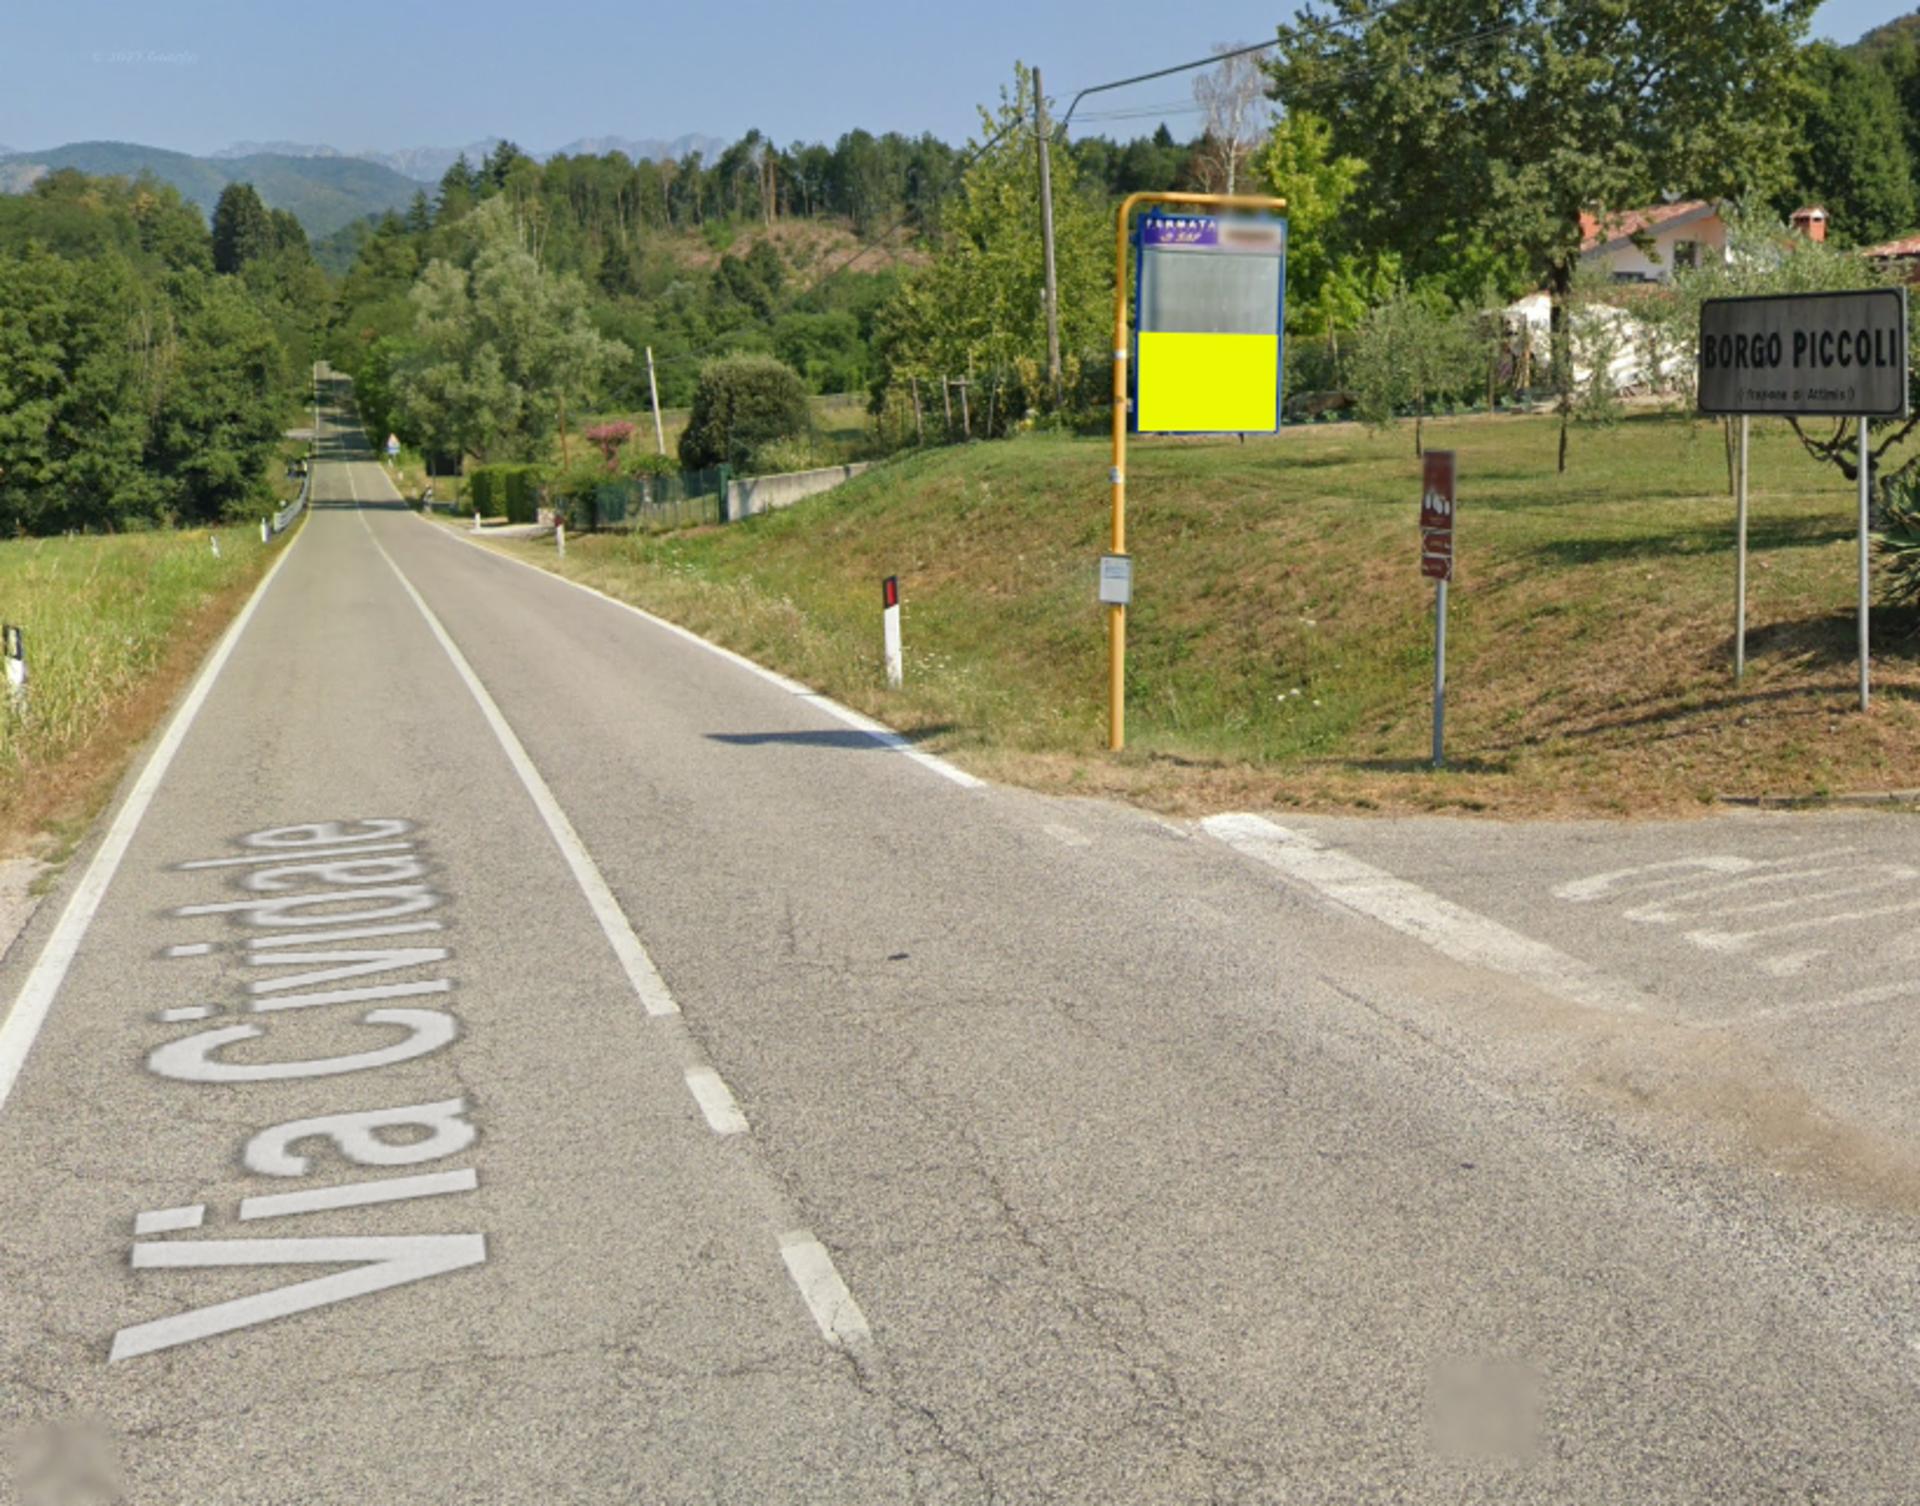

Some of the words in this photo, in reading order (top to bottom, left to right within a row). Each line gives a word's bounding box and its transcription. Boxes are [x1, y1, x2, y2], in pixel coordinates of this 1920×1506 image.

[1146, 218, 1217, 231] FERMATA
[1704, 332, 1782, 369] BORGO
[1792, 328, 1896, 369] PICCOLI
[146, 818, 460, 1083] Cividale
[109, 1098, 487, 1363] Via
